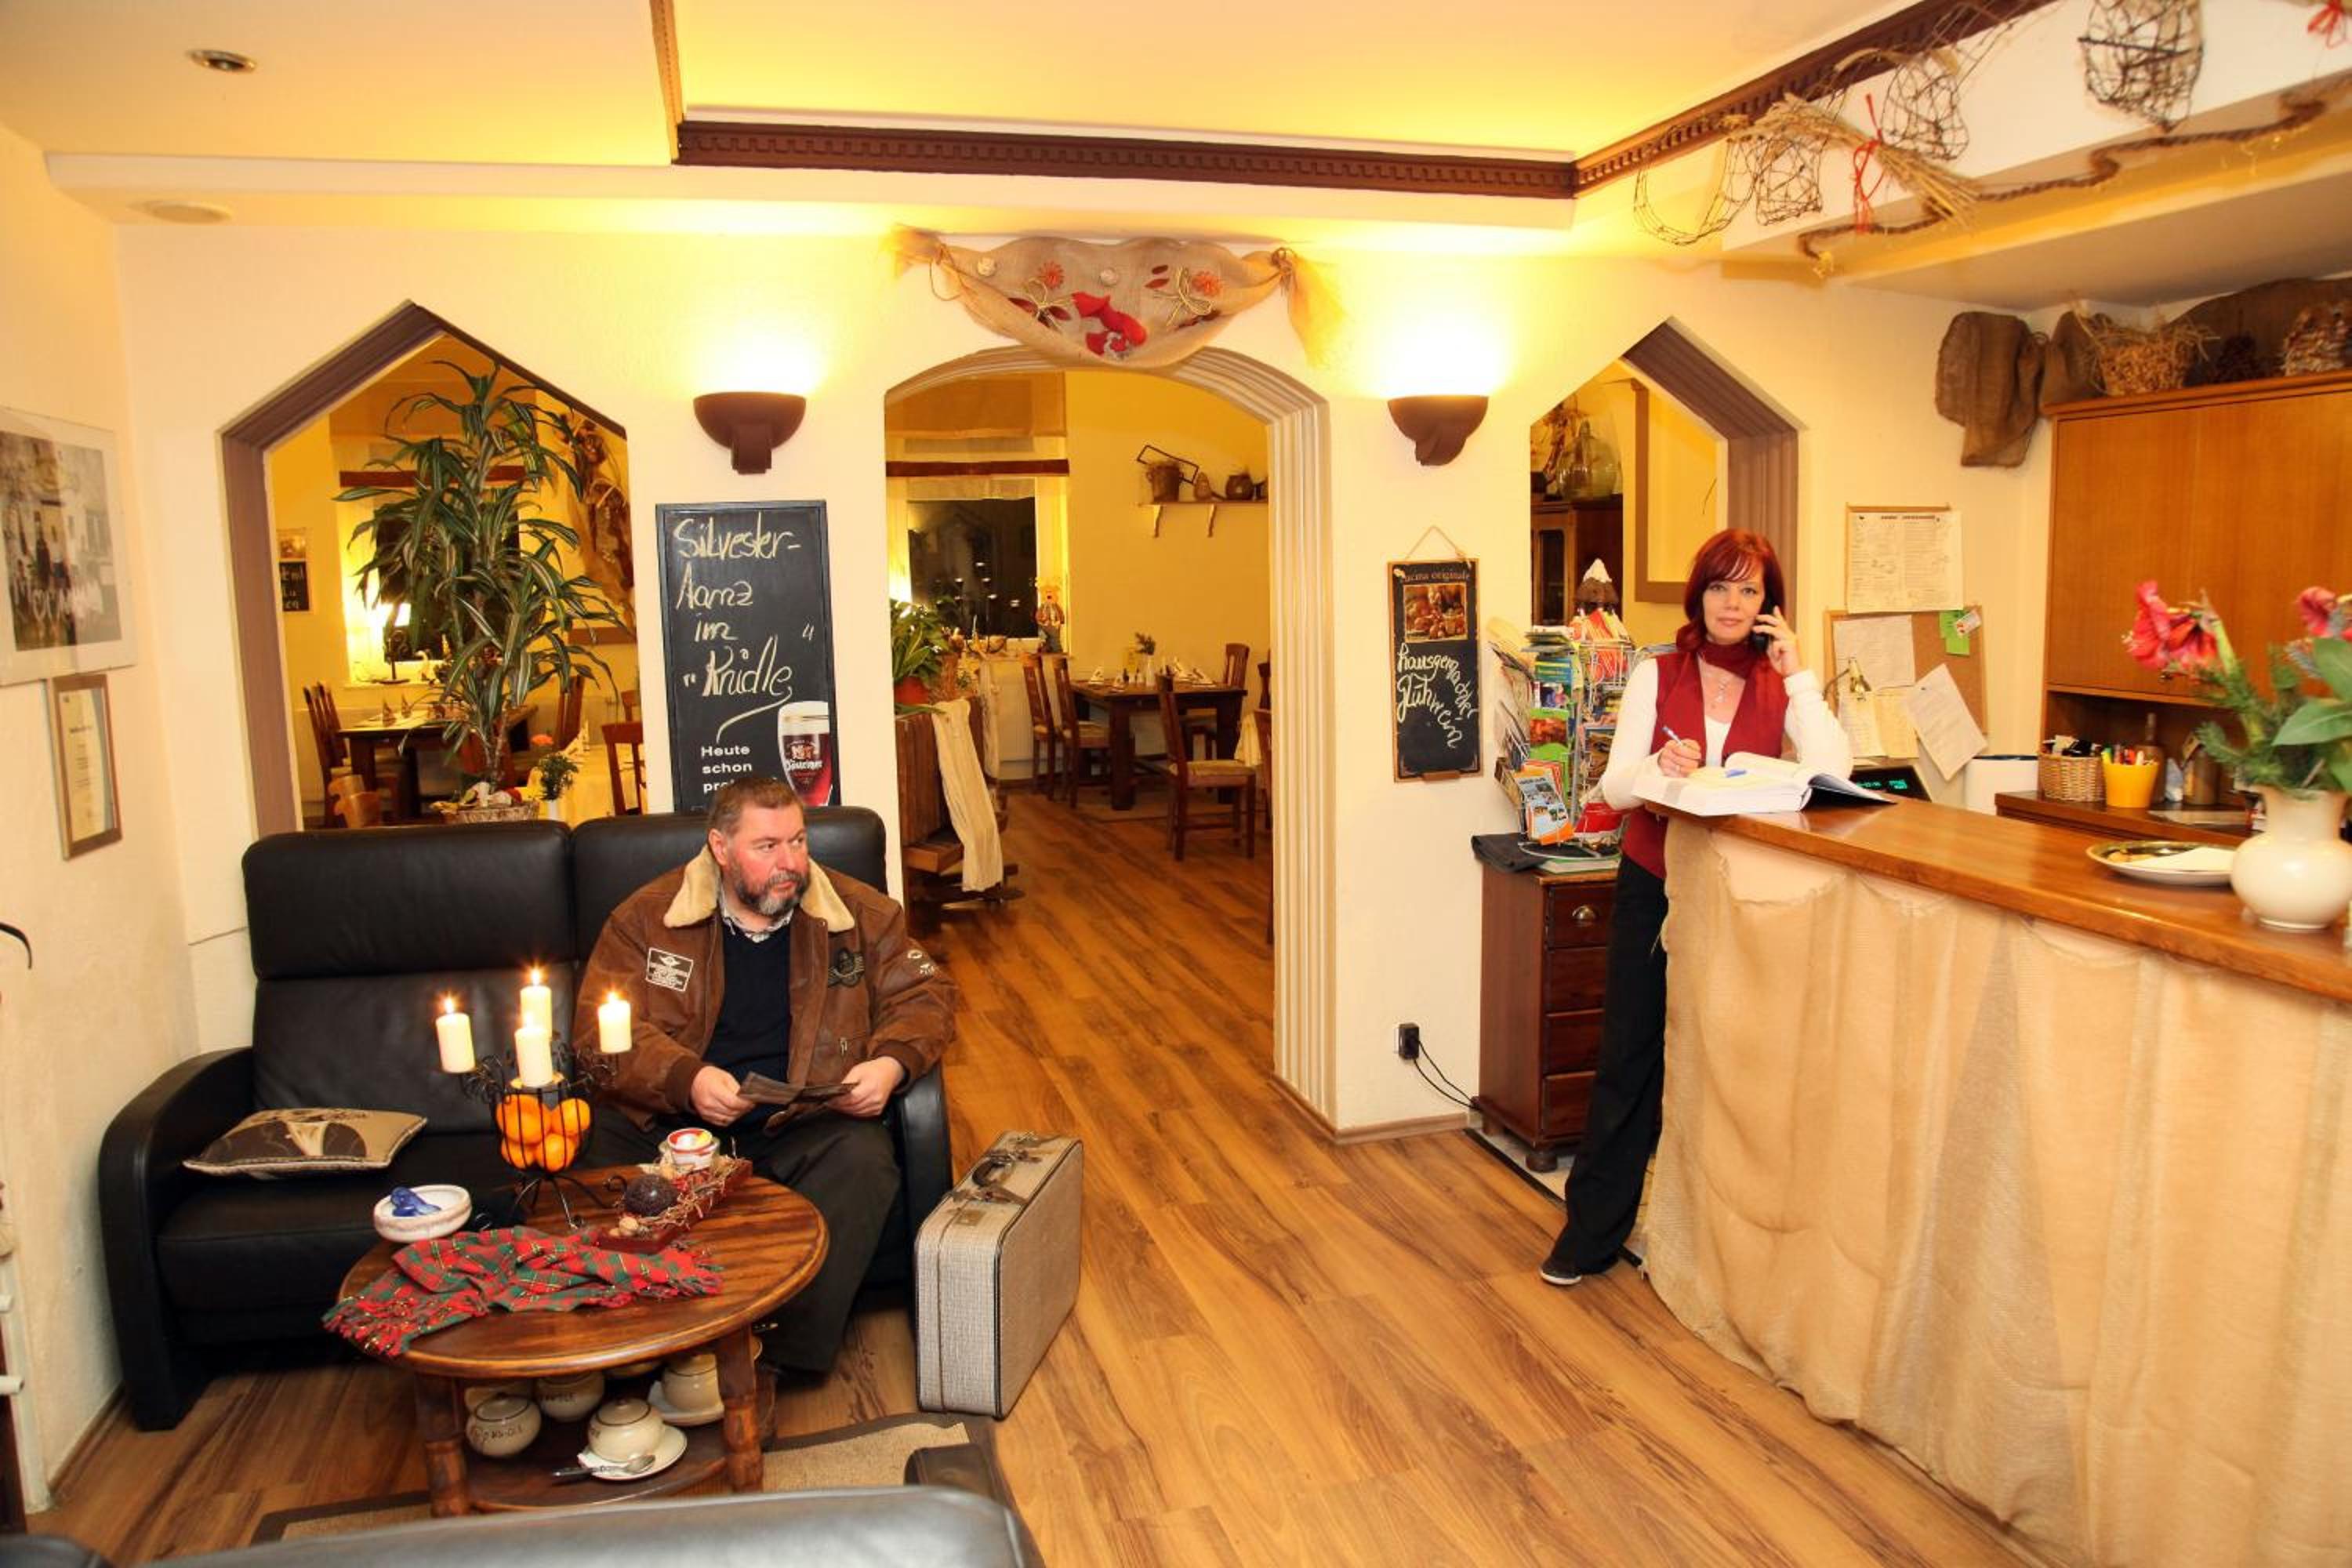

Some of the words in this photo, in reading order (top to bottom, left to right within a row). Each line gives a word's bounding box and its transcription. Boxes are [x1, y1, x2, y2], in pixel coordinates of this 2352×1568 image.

[695, 612, 739, 643] im
[700, 744, 751, 759] Heute
[702, 762, 753, 775] schon
